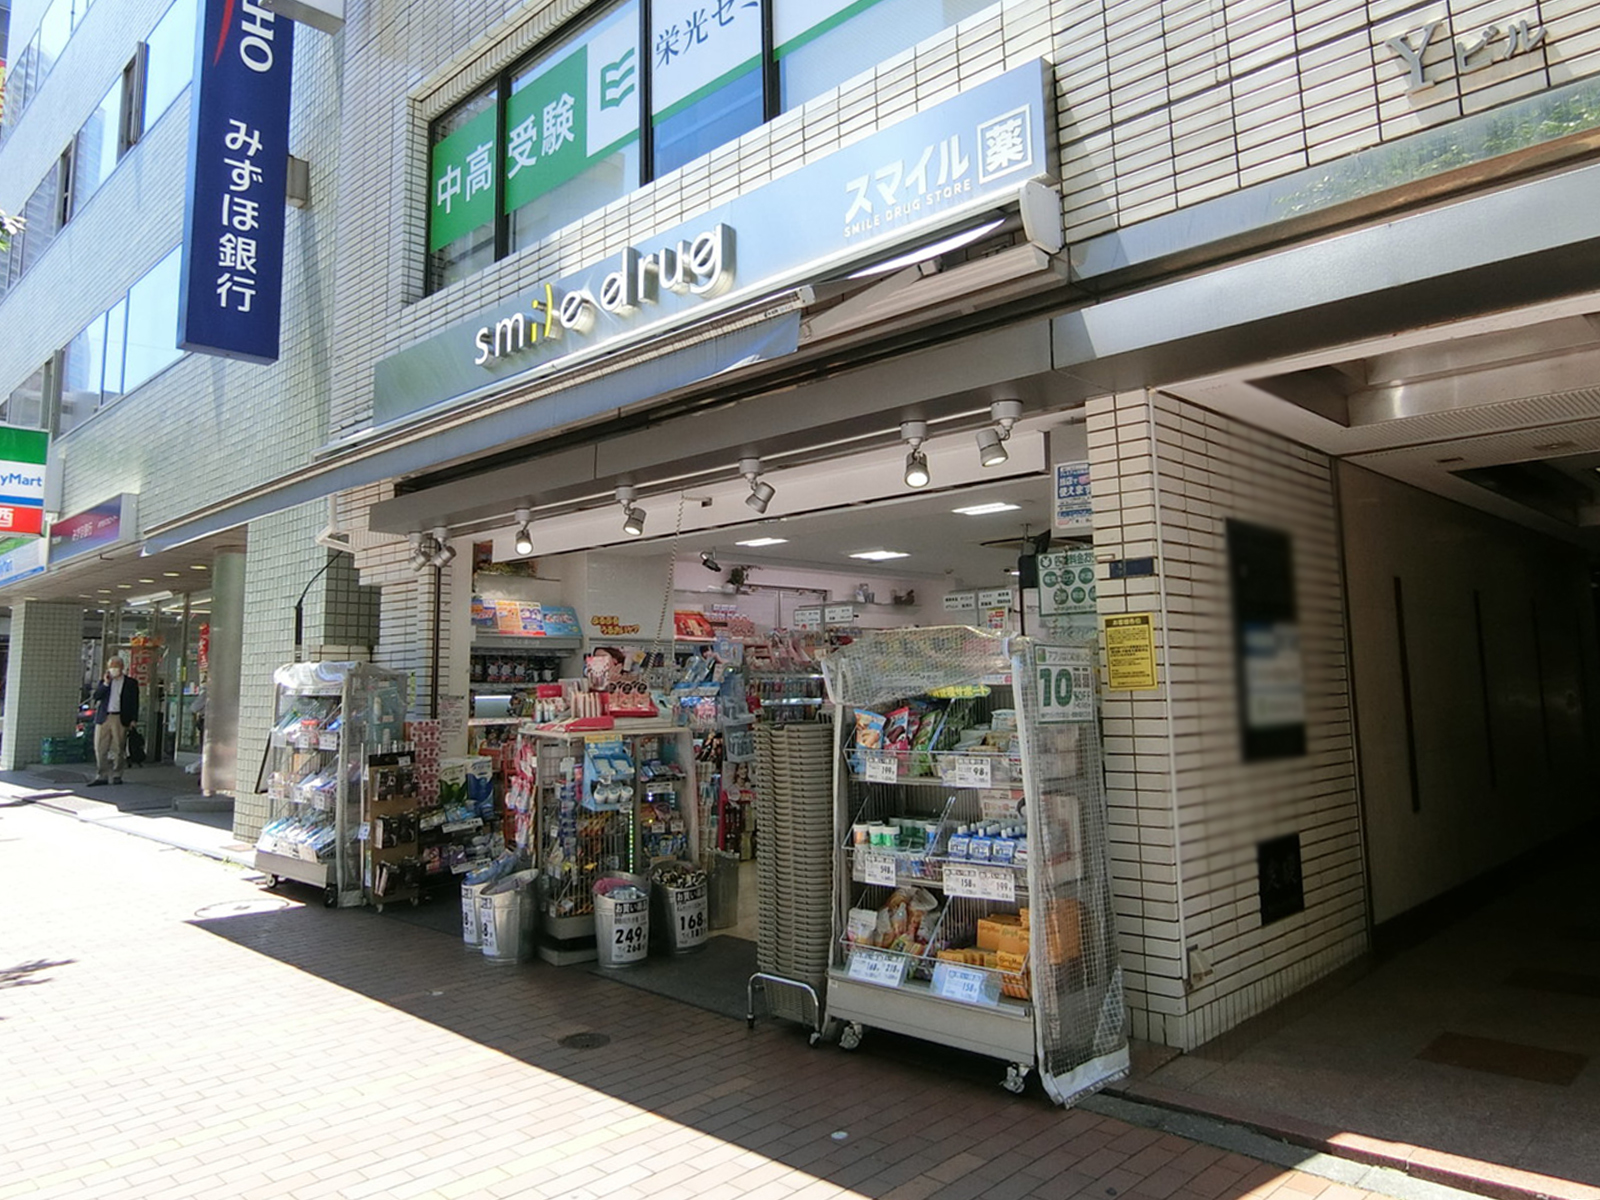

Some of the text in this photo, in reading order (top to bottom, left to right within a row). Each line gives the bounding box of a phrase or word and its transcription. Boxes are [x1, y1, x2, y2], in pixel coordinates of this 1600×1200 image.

[240, 0, 275, 72] HO
[655, 0, 758, 70] 栄光セ
[845, 134, 971, 223] スマイル
[985, 116, 1025, 173] 薬
[216, 118, 263, 313] みずほ銀行
[844, 179, 972, 238] SMILE DRUG STORE
[600, 223, 732, 315] drug
